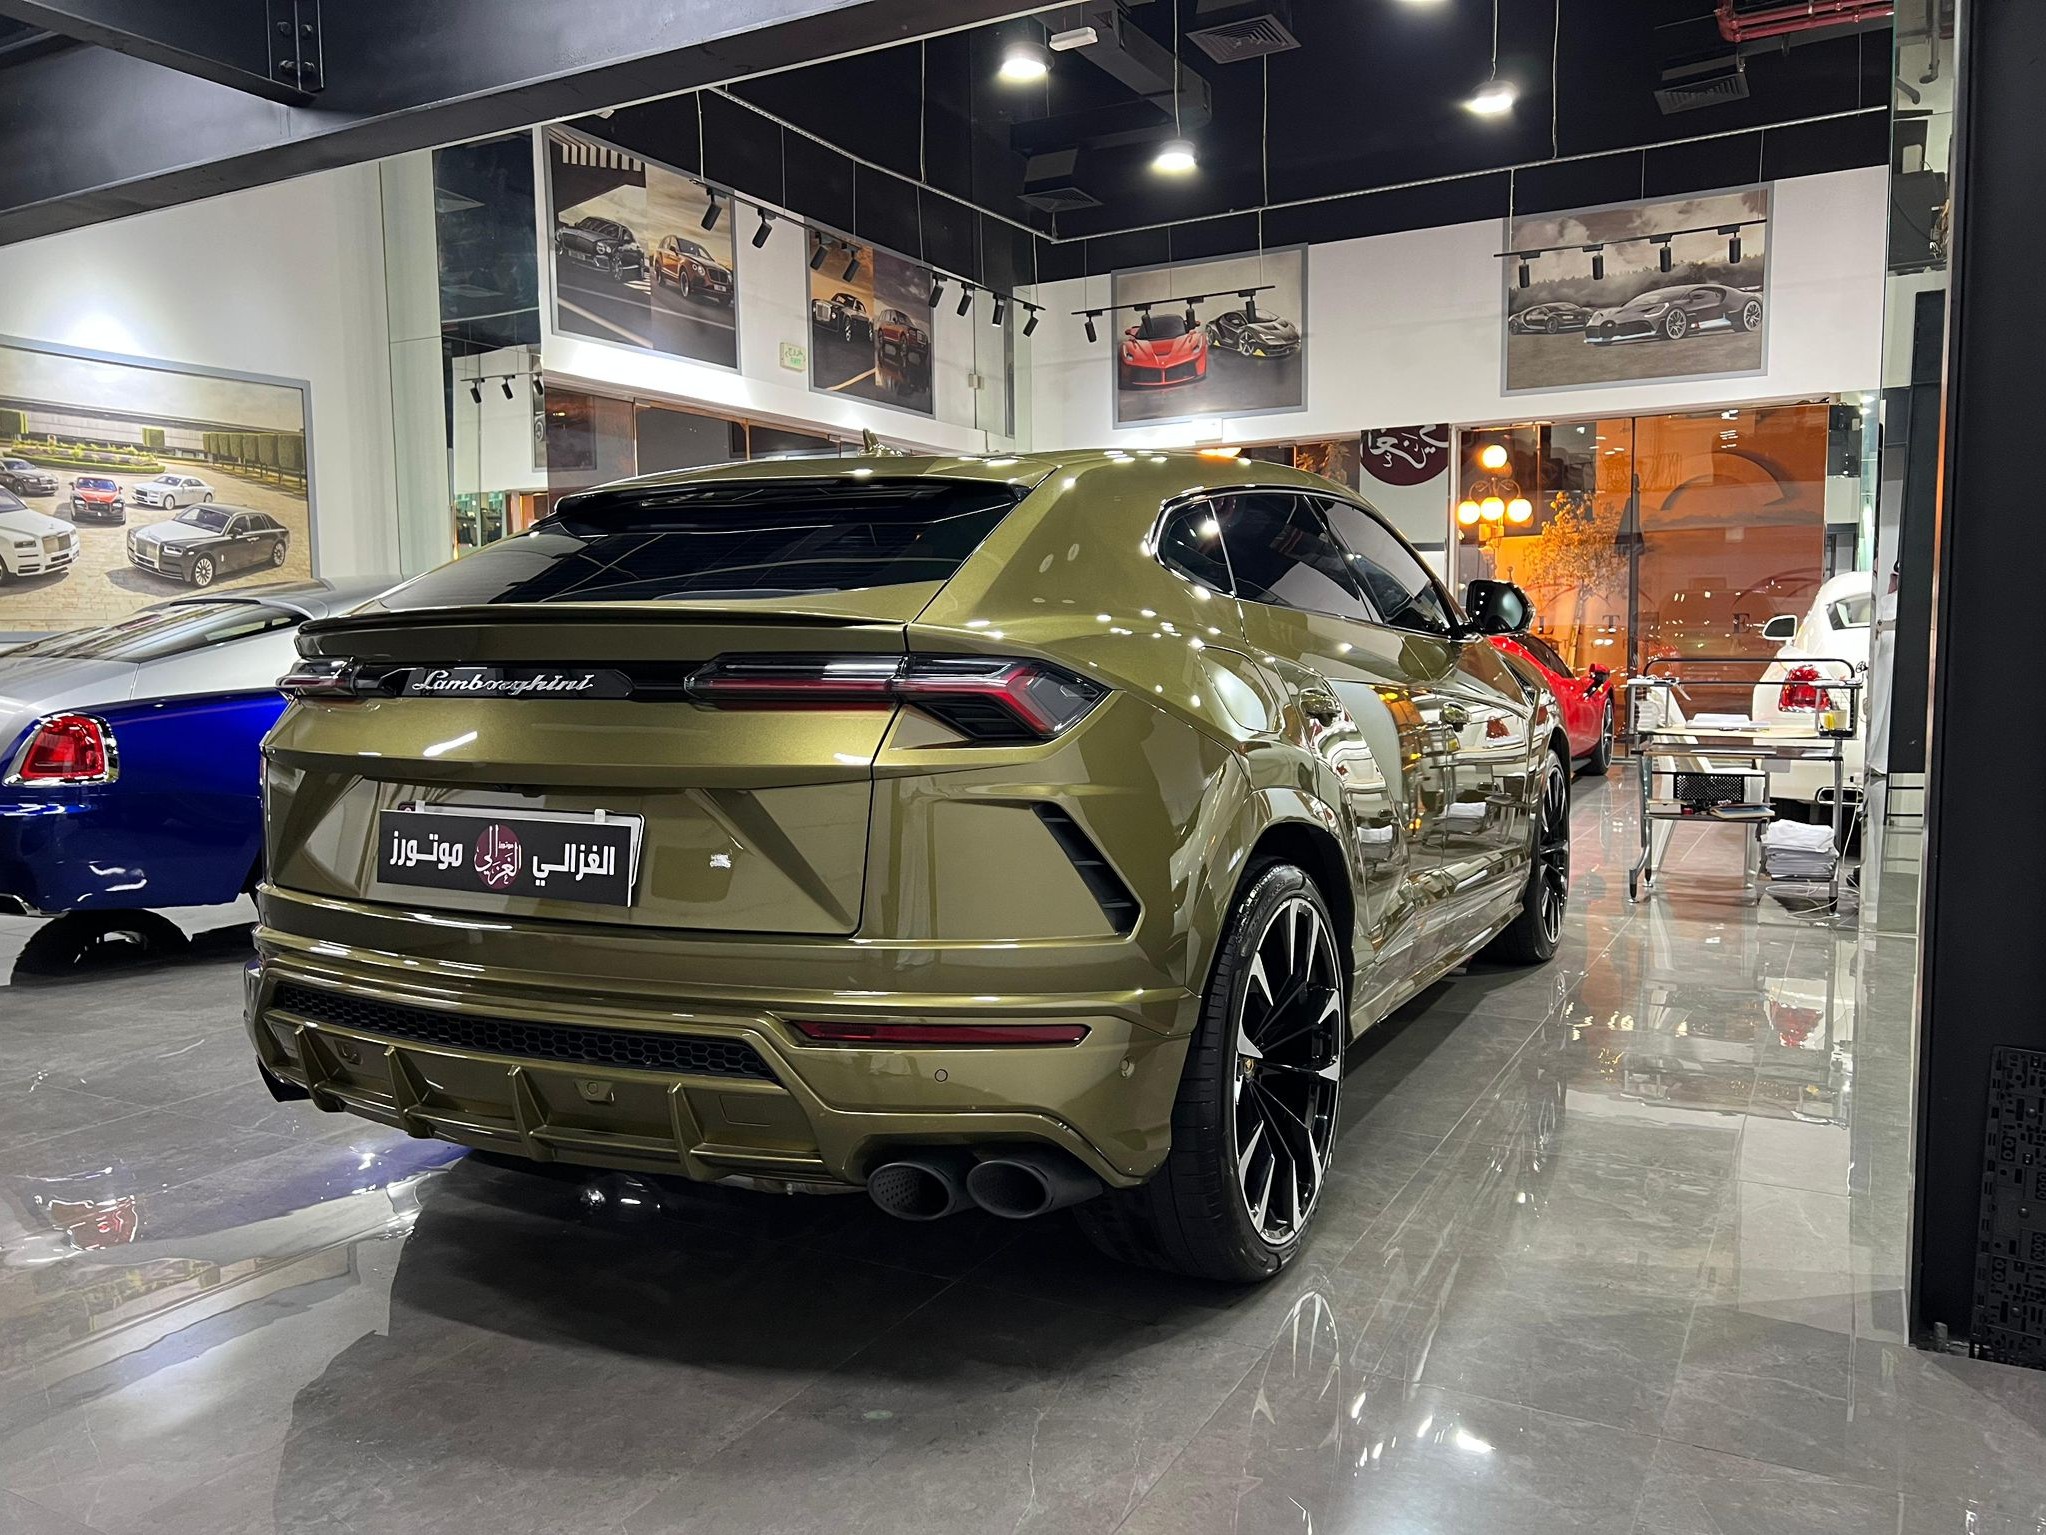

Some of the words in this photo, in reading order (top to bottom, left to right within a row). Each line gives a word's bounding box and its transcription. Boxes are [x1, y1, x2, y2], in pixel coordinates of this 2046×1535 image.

[411, 669, 595, 695] Lamborghini
[389, 830, 463, 870] موتورز
[532, 843, 616, 887] الغزالي
